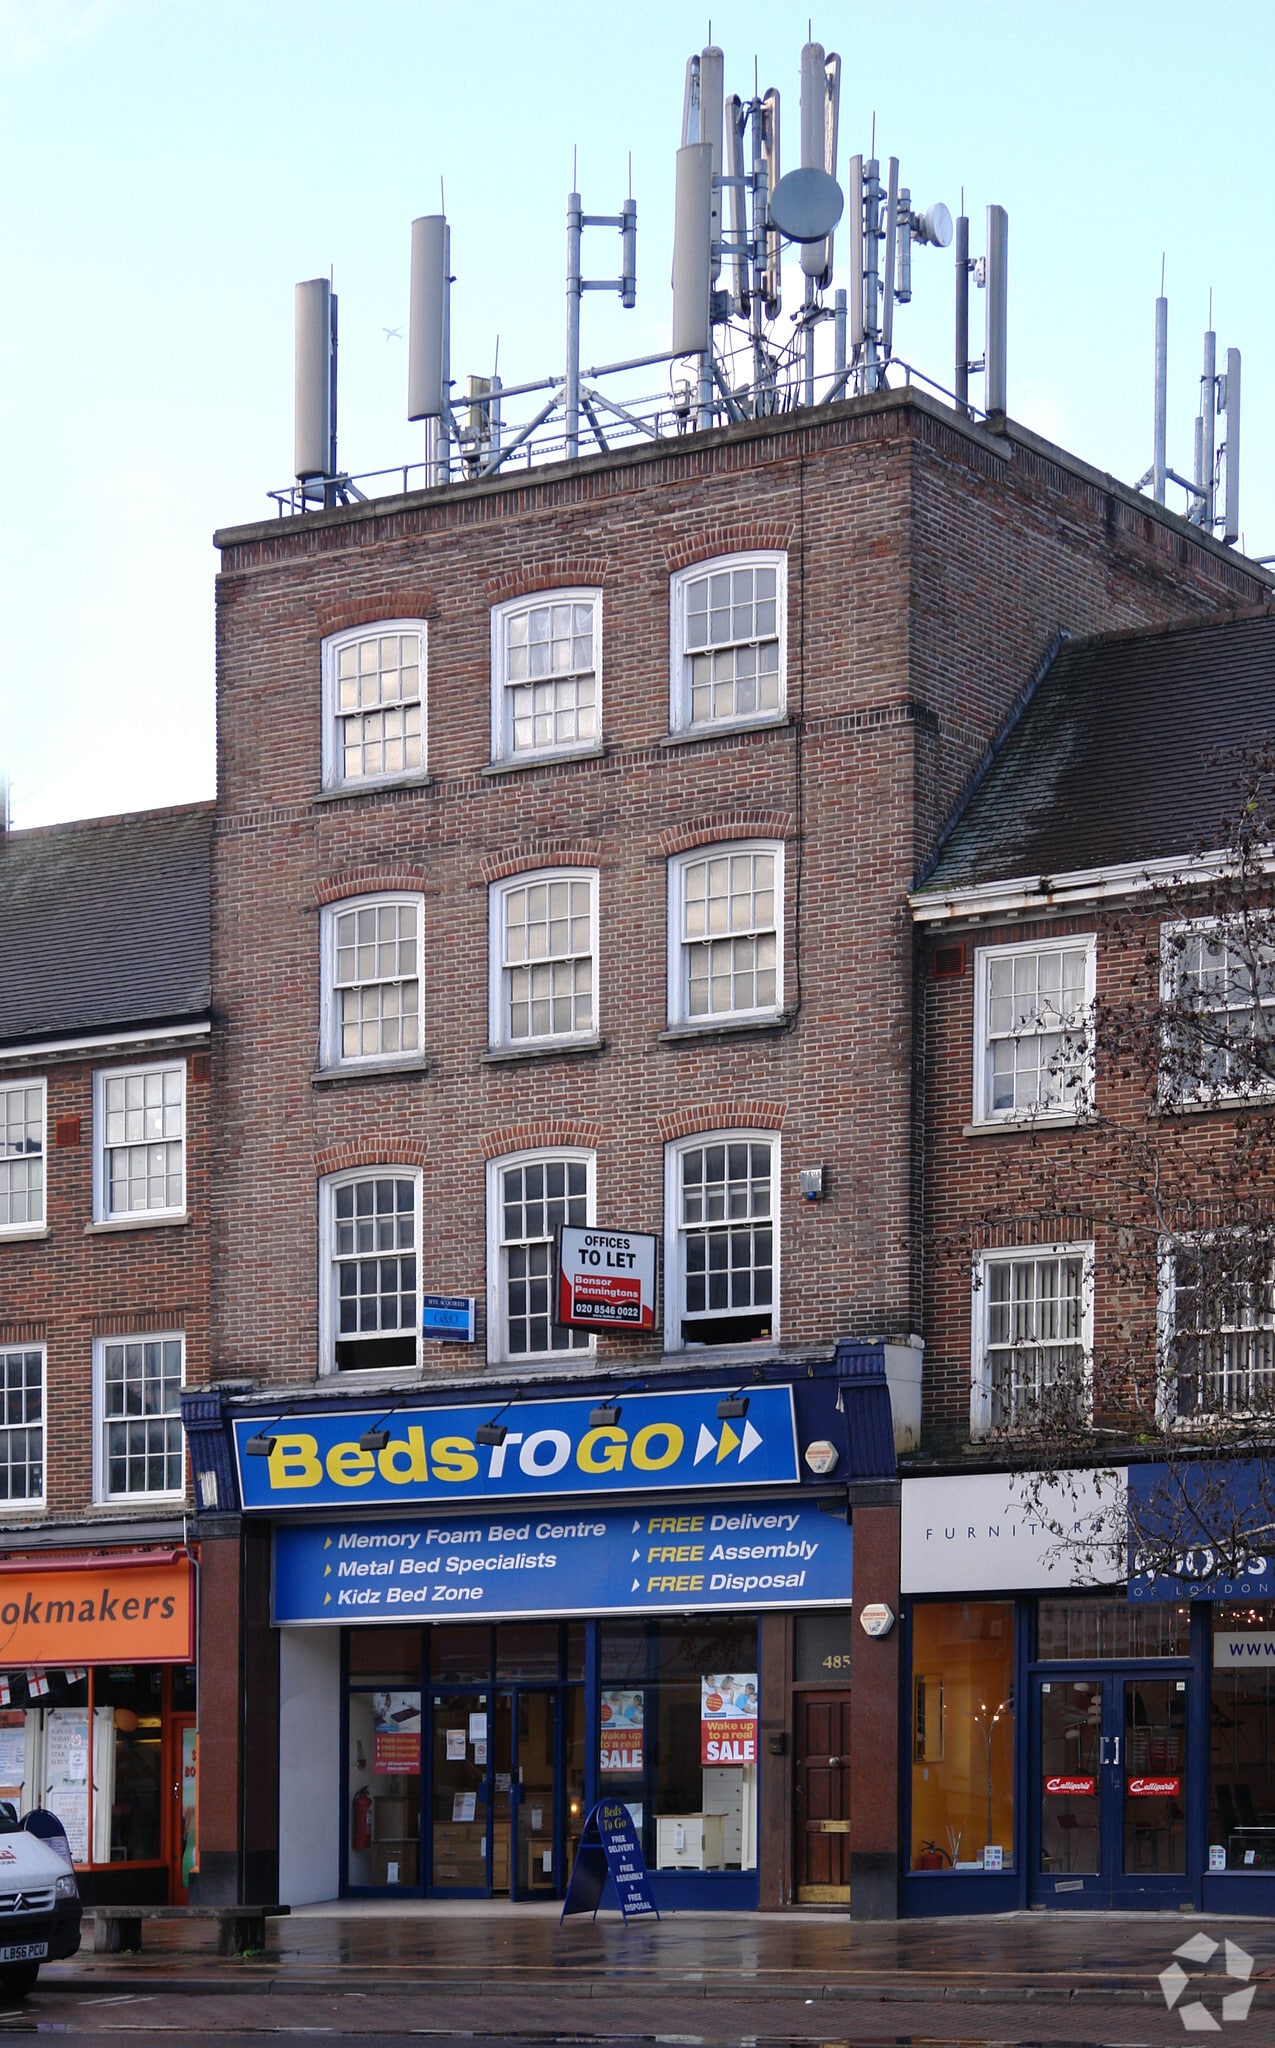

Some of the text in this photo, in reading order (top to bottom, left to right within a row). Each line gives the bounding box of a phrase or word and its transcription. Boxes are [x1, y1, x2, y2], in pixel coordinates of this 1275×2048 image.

[584, 1235, 631, 1250] OFFICES
[578, 1249, 637, 1269] TO LET
[575, 1275, 612, 1287] Bonsor
[575, 1285, 639, 1298] Penningtons
[576, 1303, 639, 1317] 020 8546 0022
[433, 1312, 459, 1325] G&O
[647, 1514, 801, 1534] FREE Delivery
[338, 1522, 607, 1550] Memory Foam Bed Centre
[647, 1540, 819, 1563] FREE Assembly
[338, 1553, 557, 1577] Metal Bed Specialists
[647, 1570, 807, 1592] FREE Disposal
[337, 1585, 483, 1605] Kidz Bed Zone
[1176, 1583, 1268, 1595] LONDON
[1, 1588, 175, 1625] okmakers
[822, 1655, 851, 1669] 485
[707, 1721, 754, 1732] Wake up
[601, 1731, 641, 1742] Wake up
[709, 1730, 753, 1740] to a real
[600, 1740, 610, 1748] to
[620, 1739, 641, 1748] real
[706, 1741, 755, 1761] SALE
[600, 1749, 643, 1769] SALE
[1046, 1778, 1090, 1791] Calligaris
[1130, 1779, 1175, 1792] Calligaris
[604, 1805, 622, 1818] Beds
[604, 1818, 627, 1831] To Go
[611, 1835, 626, 1843] FREE
[608, 1843, 635, 1854] DELIVERY
[619, 1863, 634, 1872] FREE
[616, 1872, 644, 1883] ASSEMBLY
[627, 1893, 642, 1902] FREE
[624, 1901, 652, 1912] DISPOSAL
[4, 1944, 45, 1960] LB56 PCU
